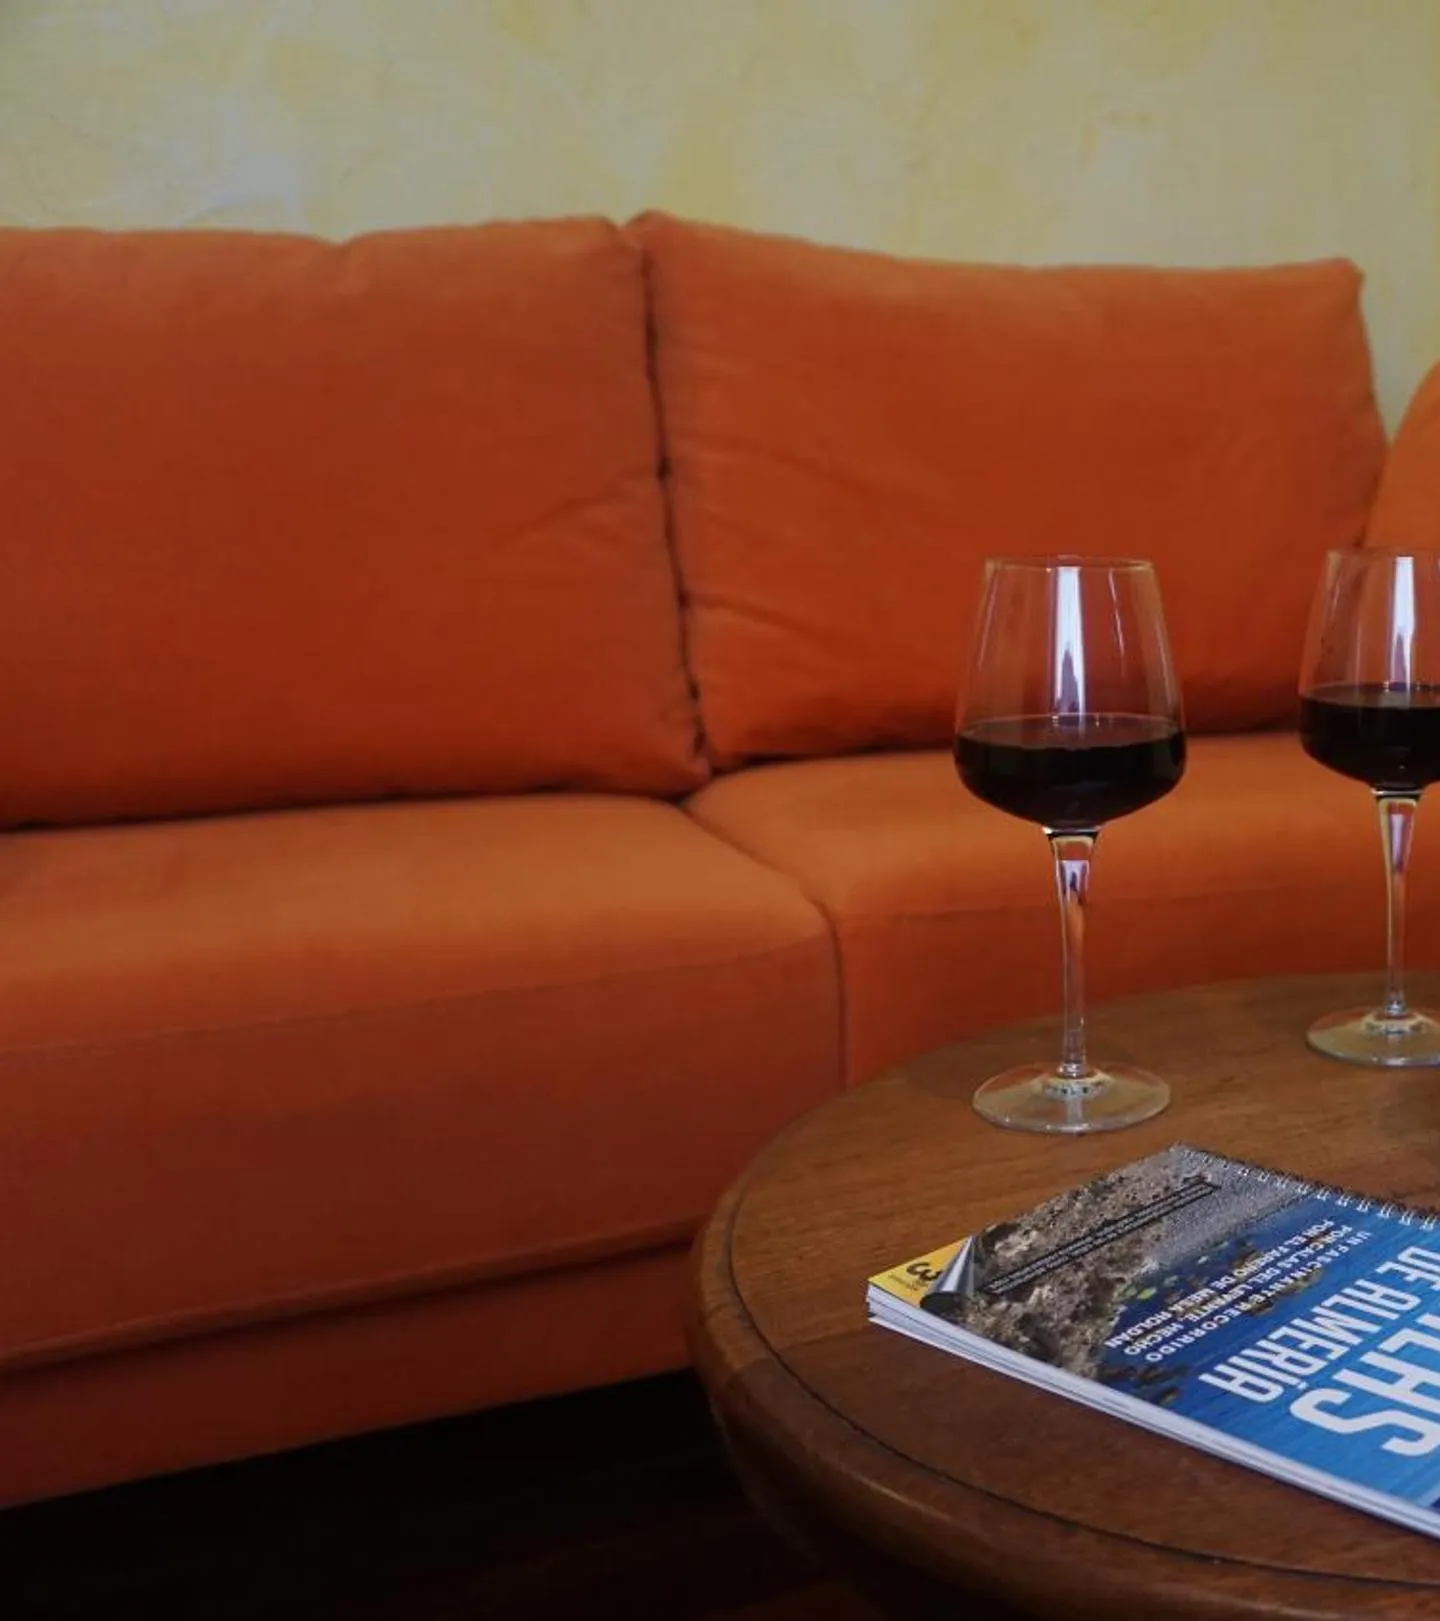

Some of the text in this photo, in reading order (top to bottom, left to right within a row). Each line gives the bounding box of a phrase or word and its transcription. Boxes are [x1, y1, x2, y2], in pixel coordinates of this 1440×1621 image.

[1301, 1219, 1336, 1236] POR
[1318, 1225, 1354, 1242] POR
[1282, 1235, 1308, 1247] EL
[1273, 1241, 1326, 1268] CALAS
[1208, 1275, 1236, 1288] DE
[1244, 1267, 1280, 1285] DEL
[1141, 1231, 1373, 1363] UN FASCINANTE RECORRIDO
[1119, 1321, 1183, 1356] HECHO
[1196, 1279, 1420, 1403] ALMERÍA
